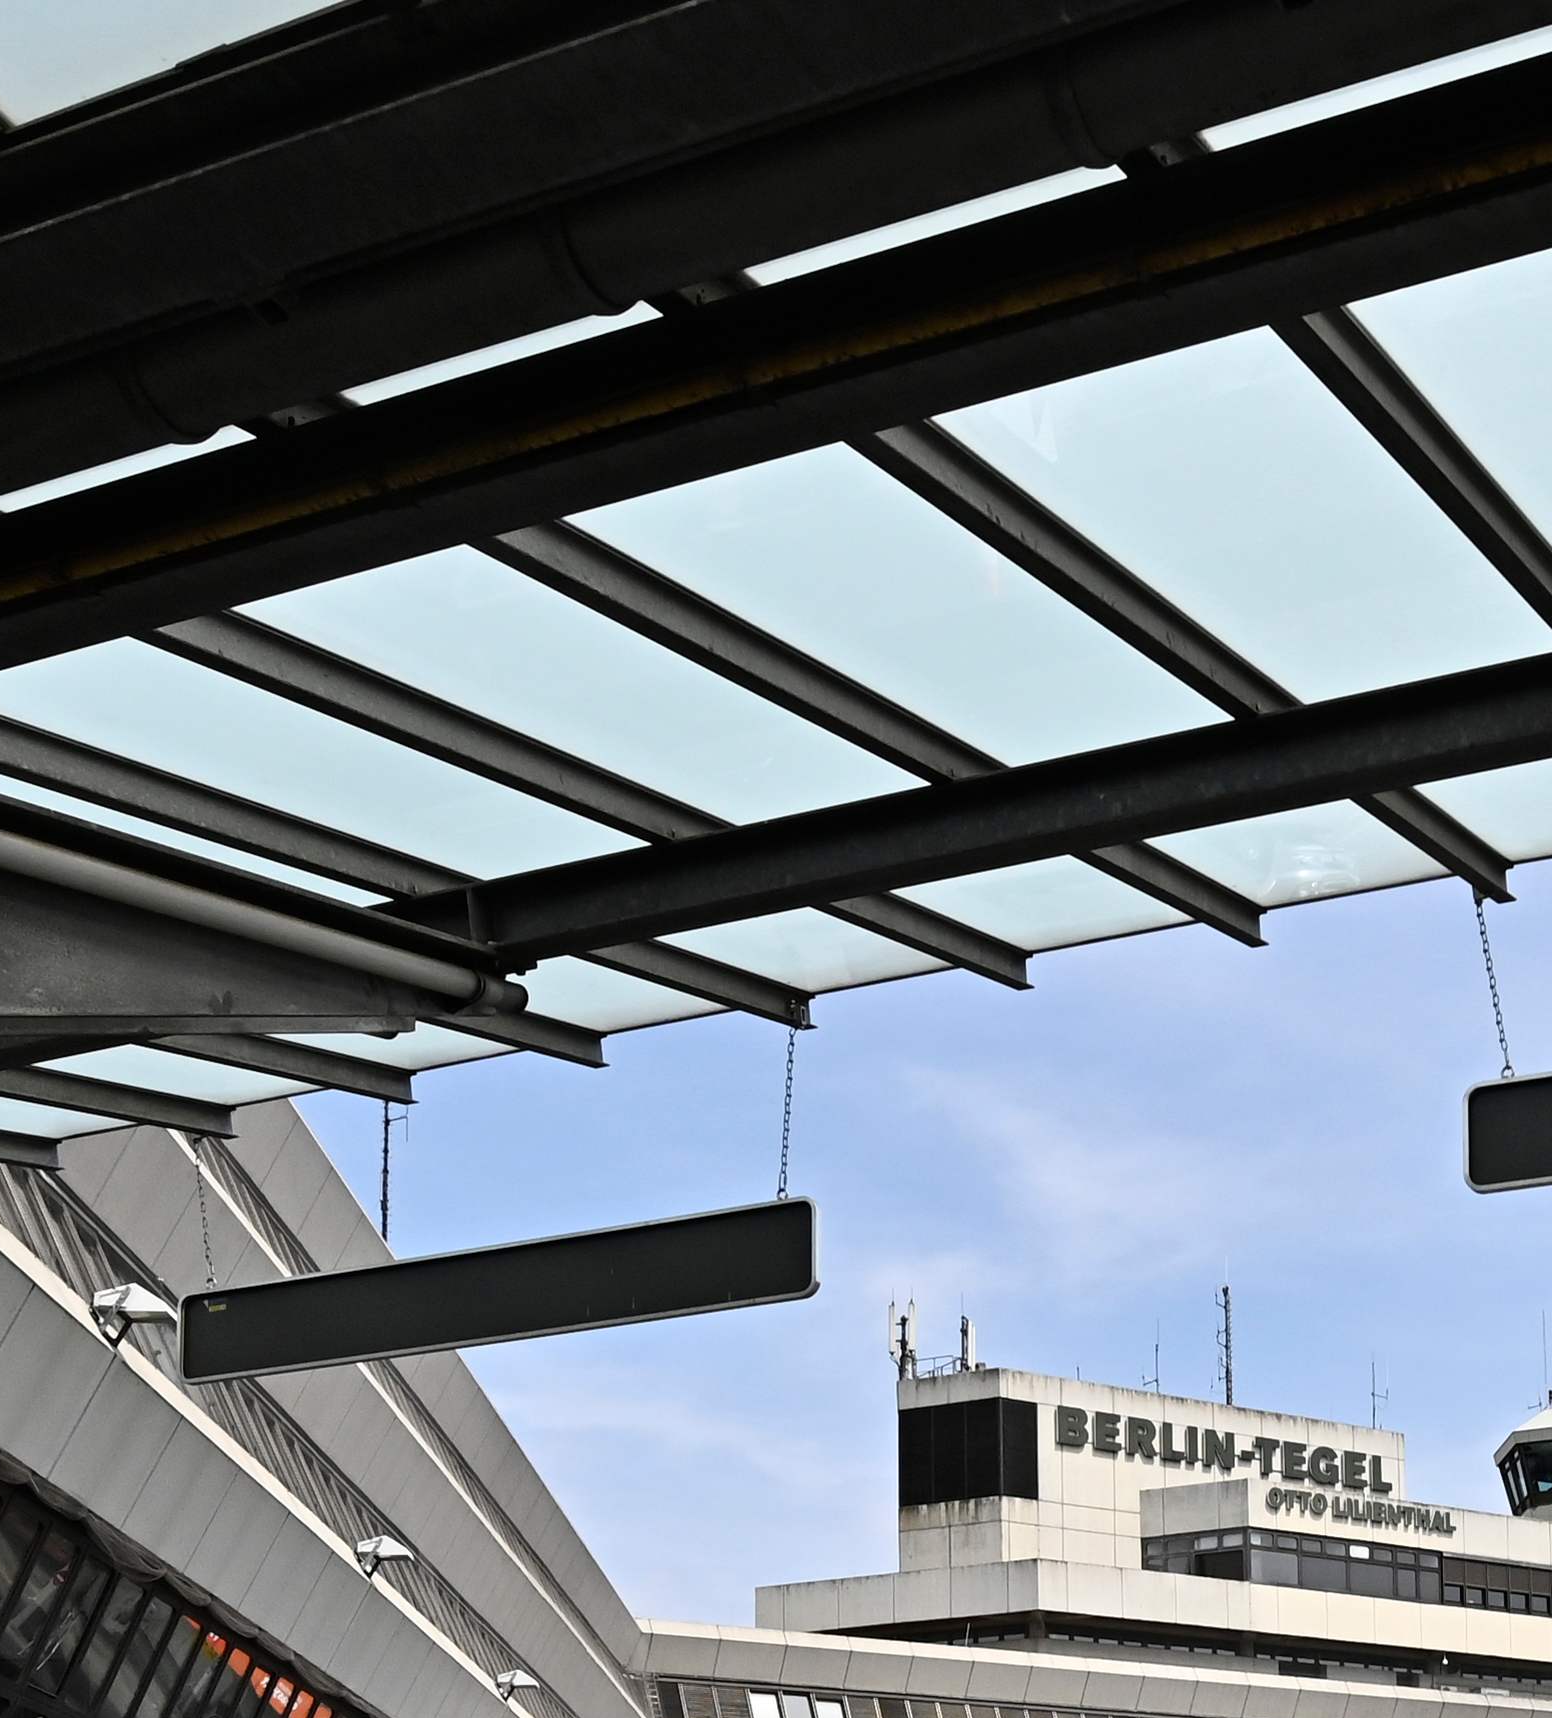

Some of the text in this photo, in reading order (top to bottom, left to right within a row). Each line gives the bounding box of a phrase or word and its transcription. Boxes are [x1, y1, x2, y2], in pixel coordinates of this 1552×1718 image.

[1055, 1405, 1393, 1493] BERLIN-TEGEL
[1266, 1486, 1457, 1533] OTTO LILIENTHAL
